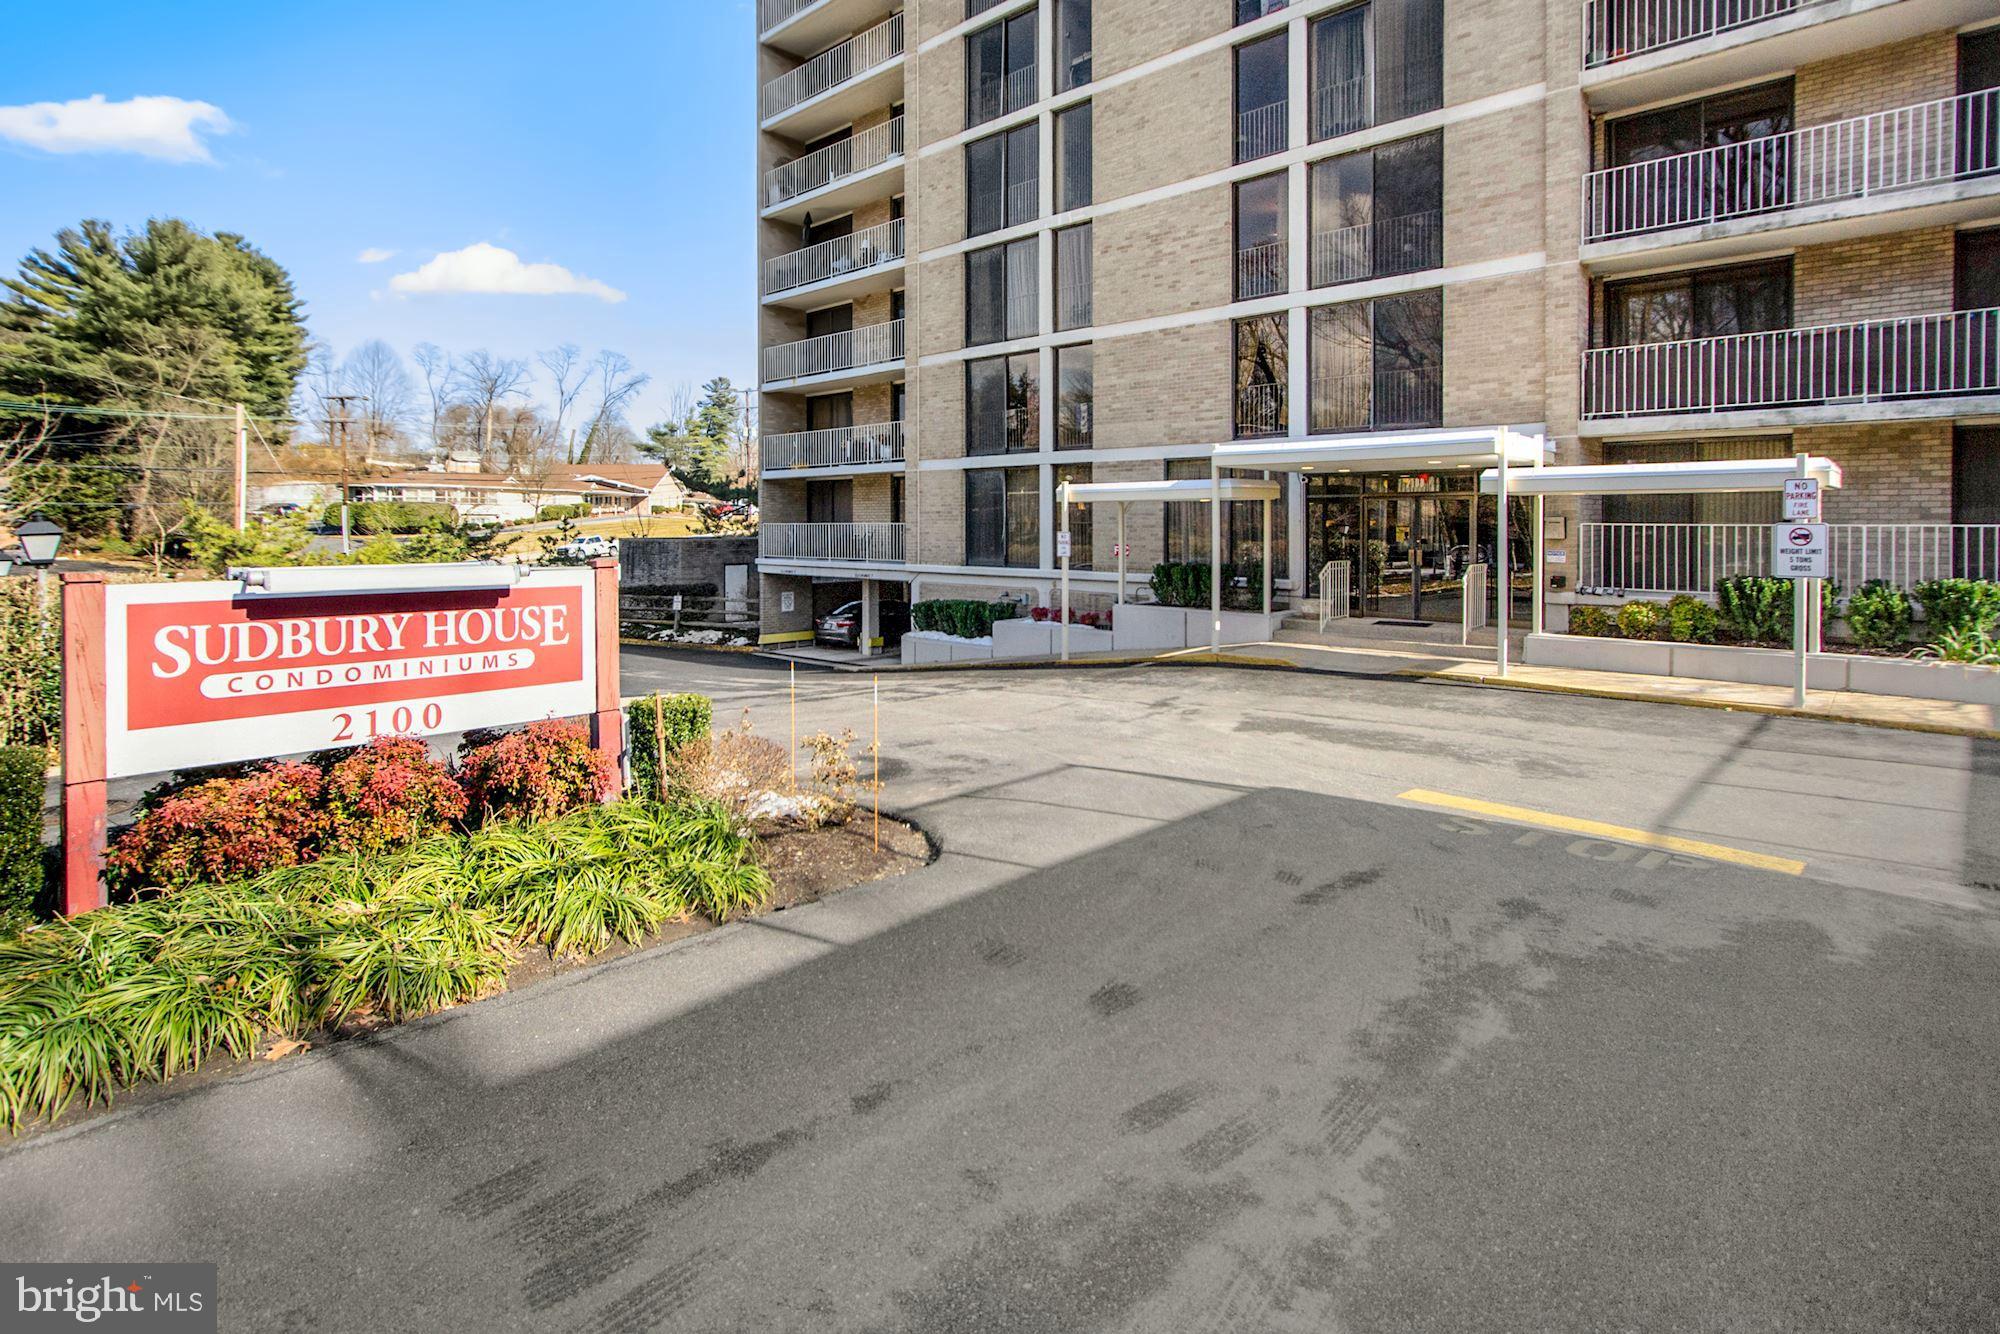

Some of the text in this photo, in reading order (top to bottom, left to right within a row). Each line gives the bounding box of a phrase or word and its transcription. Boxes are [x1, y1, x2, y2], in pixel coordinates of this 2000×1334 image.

[1785, 492, 1817, 500] PARKING
[1794, 482, 1808, 490] NO
[1790, 564, 1812, 572] GROSS
[151, 604, 570, 680] SUDBURY HOUSE
[227, 652, 520, 694] CONDOMINIUMS
[331, 702, 443, 742] 2100
